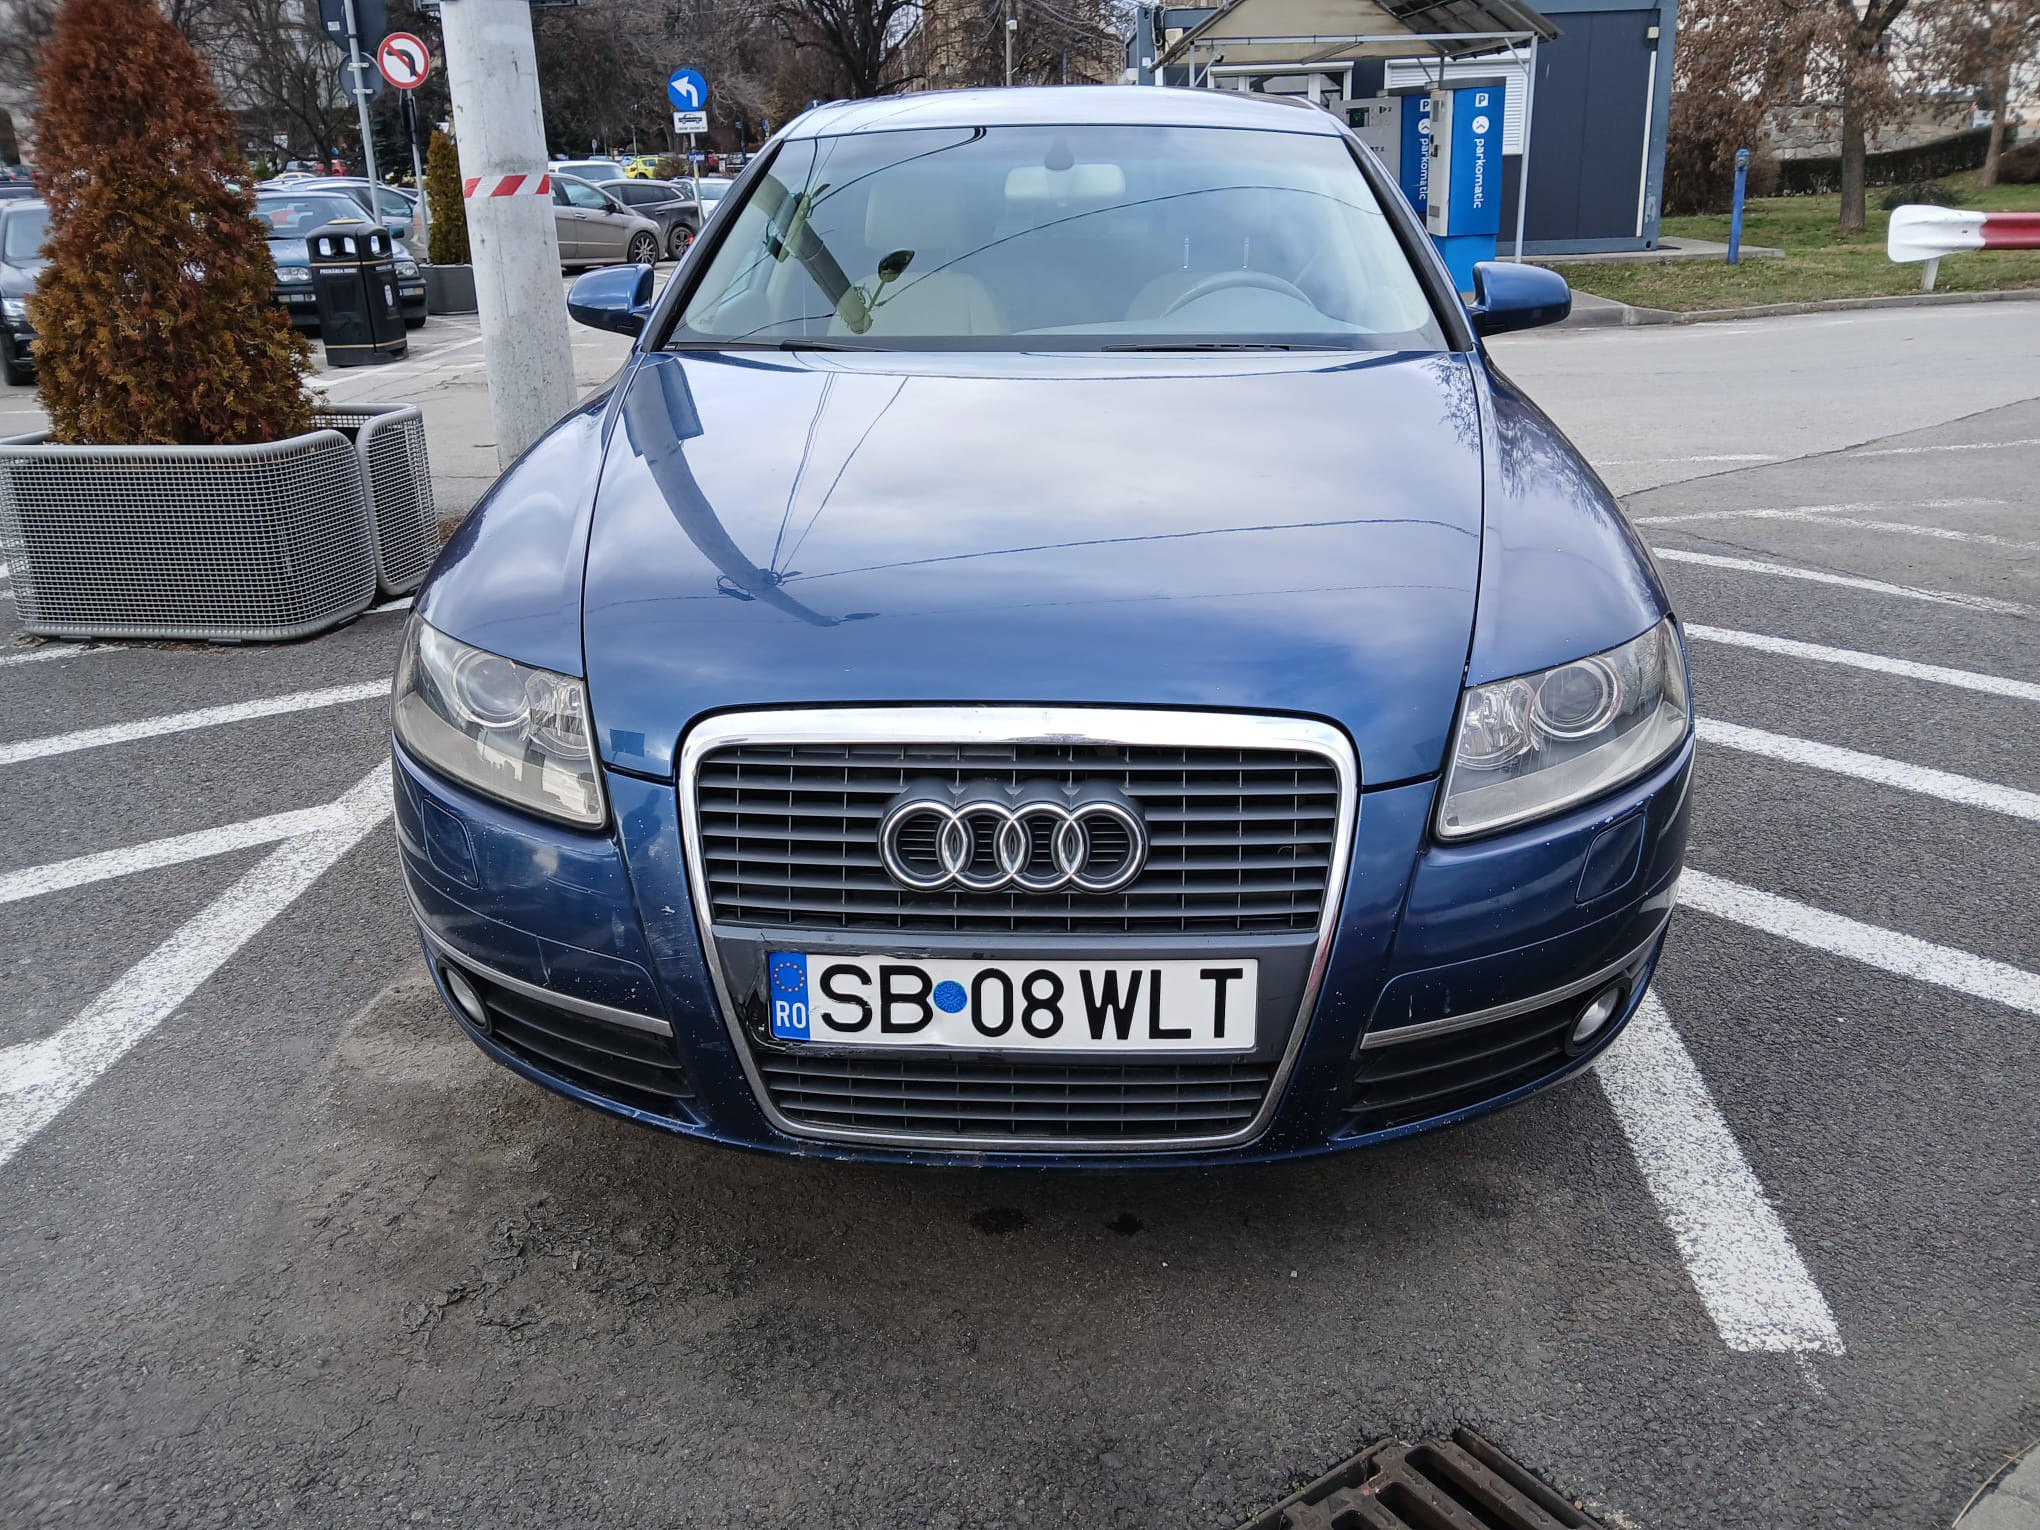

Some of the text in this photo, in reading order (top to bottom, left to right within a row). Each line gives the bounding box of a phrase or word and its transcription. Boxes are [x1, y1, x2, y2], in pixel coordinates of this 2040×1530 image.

[1418, 138, 1429, 200] parkomatic
[1473, 138, 1486, 208] parkomatic
[775, 1000, 806, 1028] RO
[820, 964, 933, 1033] SB
[971, 968, 1064, 1039] 08
[1080, 968, 1244, 1040] WLT
